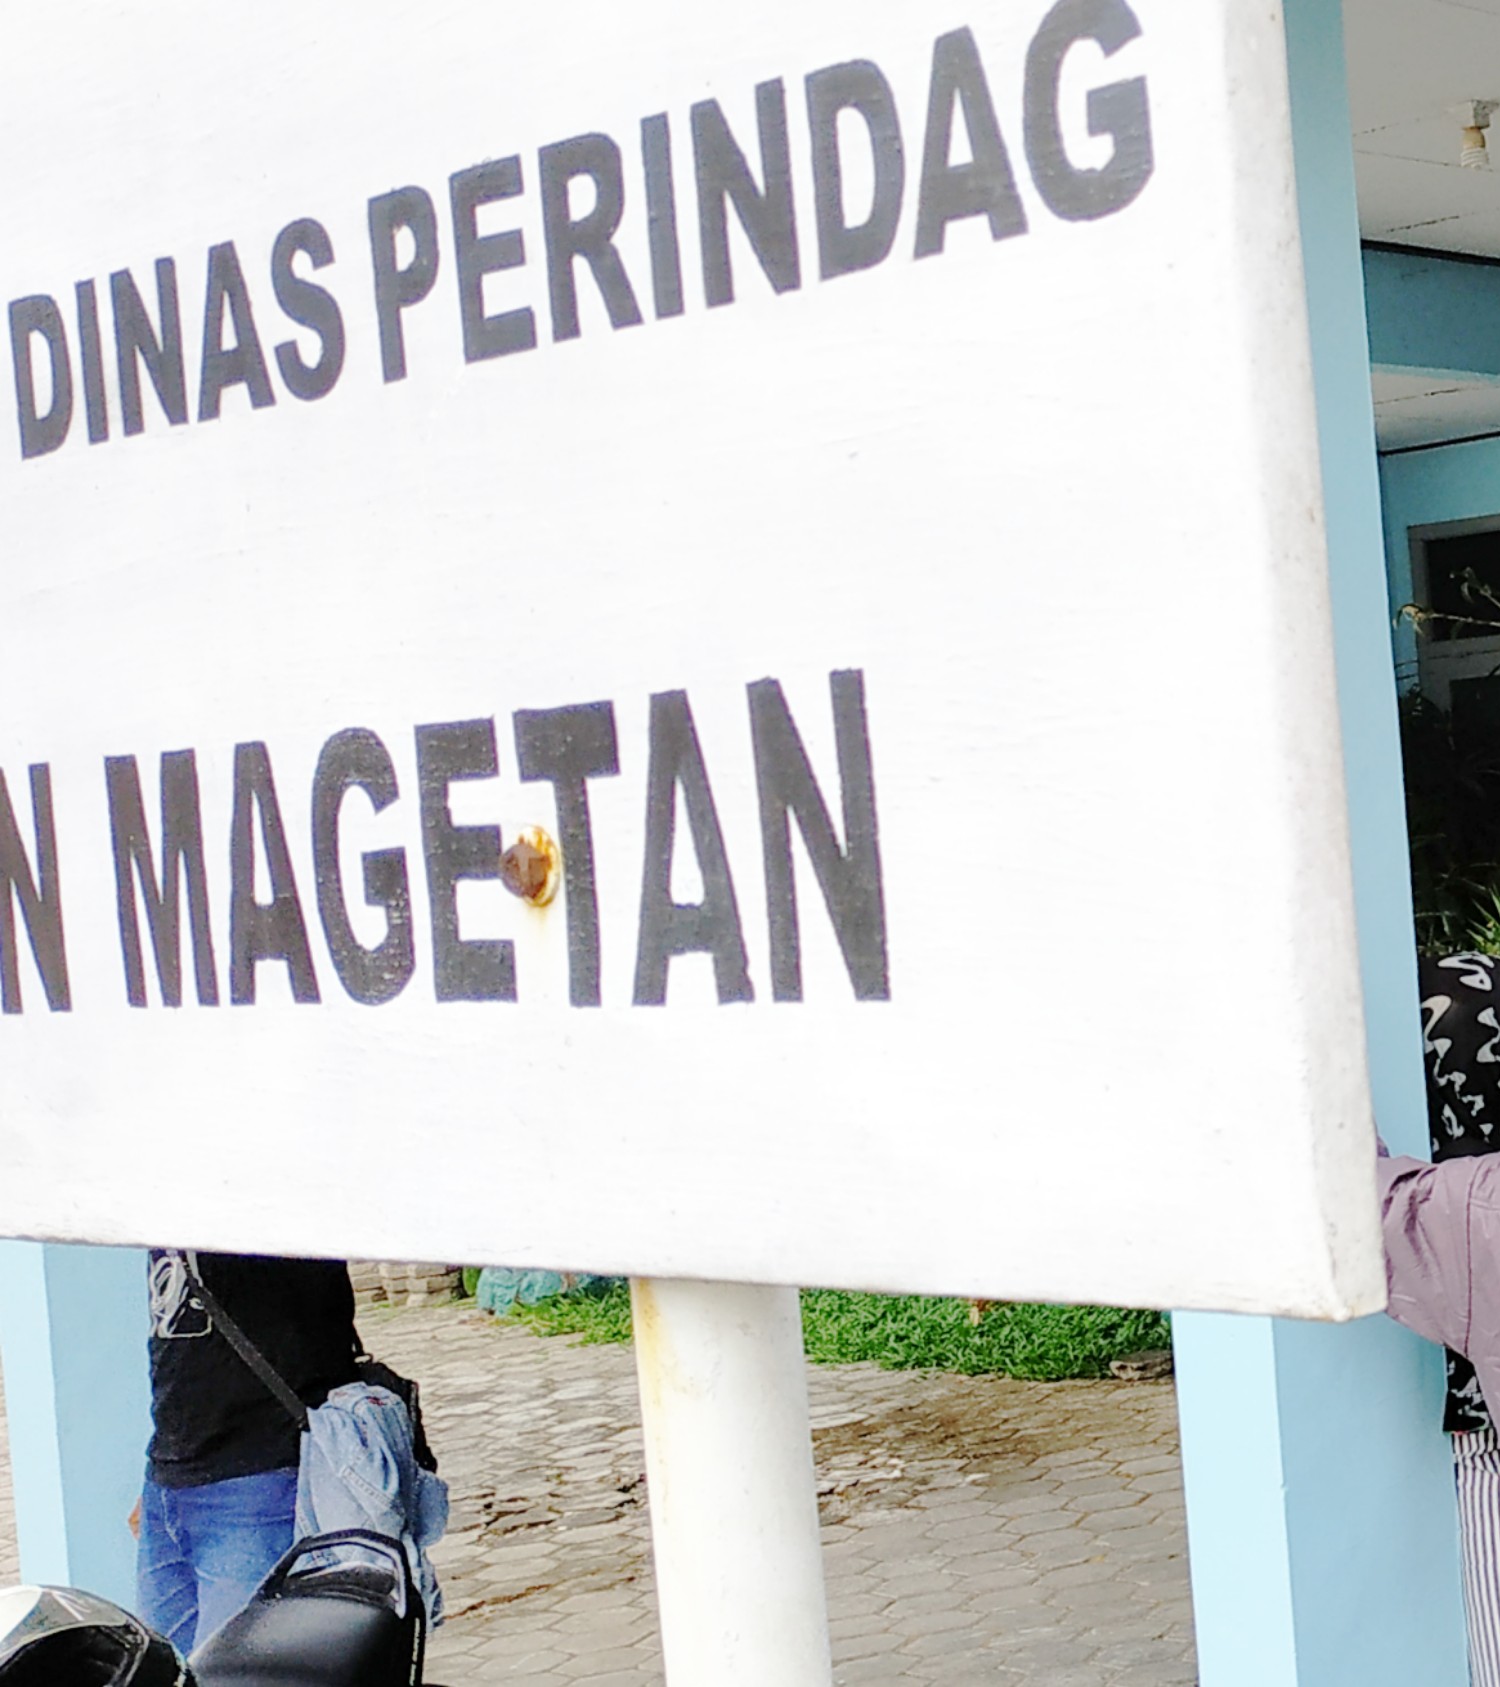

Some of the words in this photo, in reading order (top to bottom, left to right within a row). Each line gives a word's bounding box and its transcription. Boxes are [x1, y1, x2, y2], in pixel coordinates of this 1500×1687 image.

[7, 217, 346, 461] DINAS
[367, 0, 1155, 384] PERINDAG
[103, 668, 891, 1009] MAGETAN
